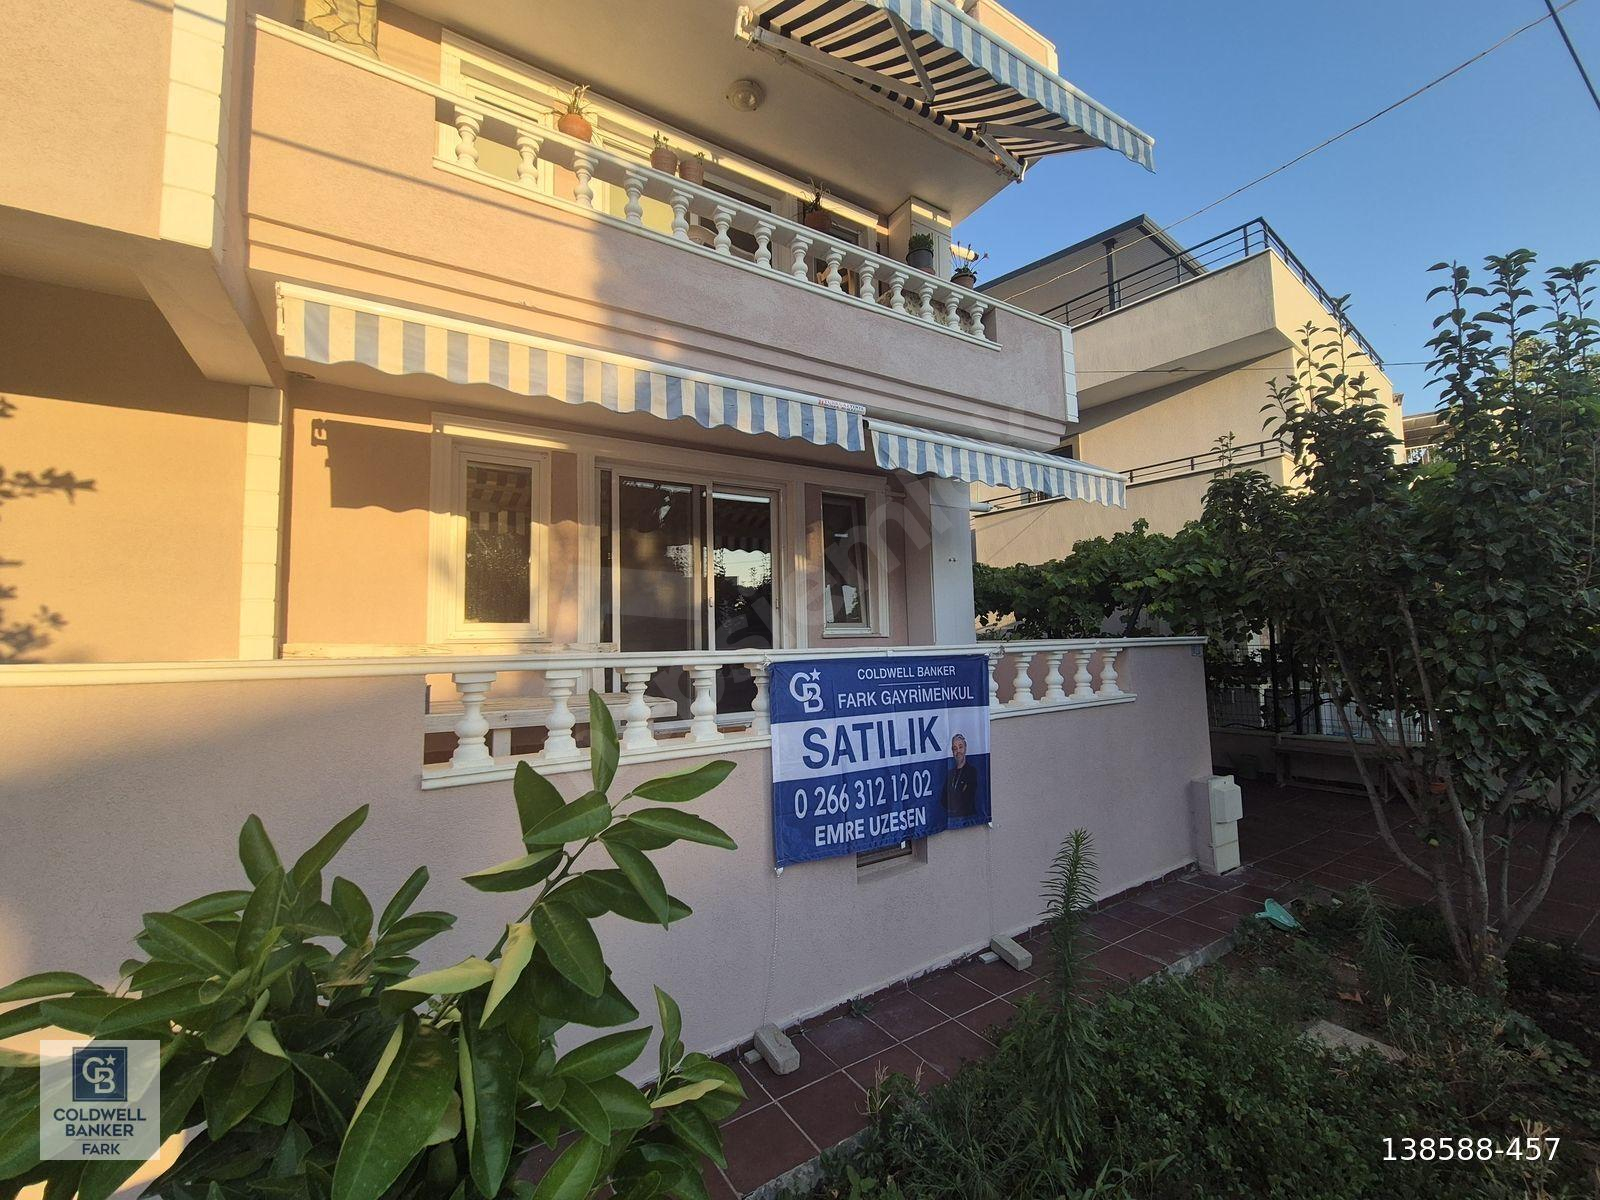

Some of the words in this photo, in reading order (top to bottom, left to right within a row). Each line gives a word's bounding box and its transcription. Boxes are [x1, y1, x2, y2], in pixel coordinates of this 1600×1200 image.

[857, 667, 915, 680] COLDWELL
[917, 665, 956, 678] BANKER
[838, 691, 877, 709] FARK
[881, 685, 975, 706] GAYRİMENKUL
[802, 715, 942, 770] SATILIK
[794, 788, 808, 819] 0
[813, 783, 850, 816] 266
[854, 776, 887, 810] 312
[891, 772, 910, 802] 12
[912, 769, 933, 799] 02
[815, 818, 865, 847] EMRE
[869, 806, 927, 837] UZESEN
